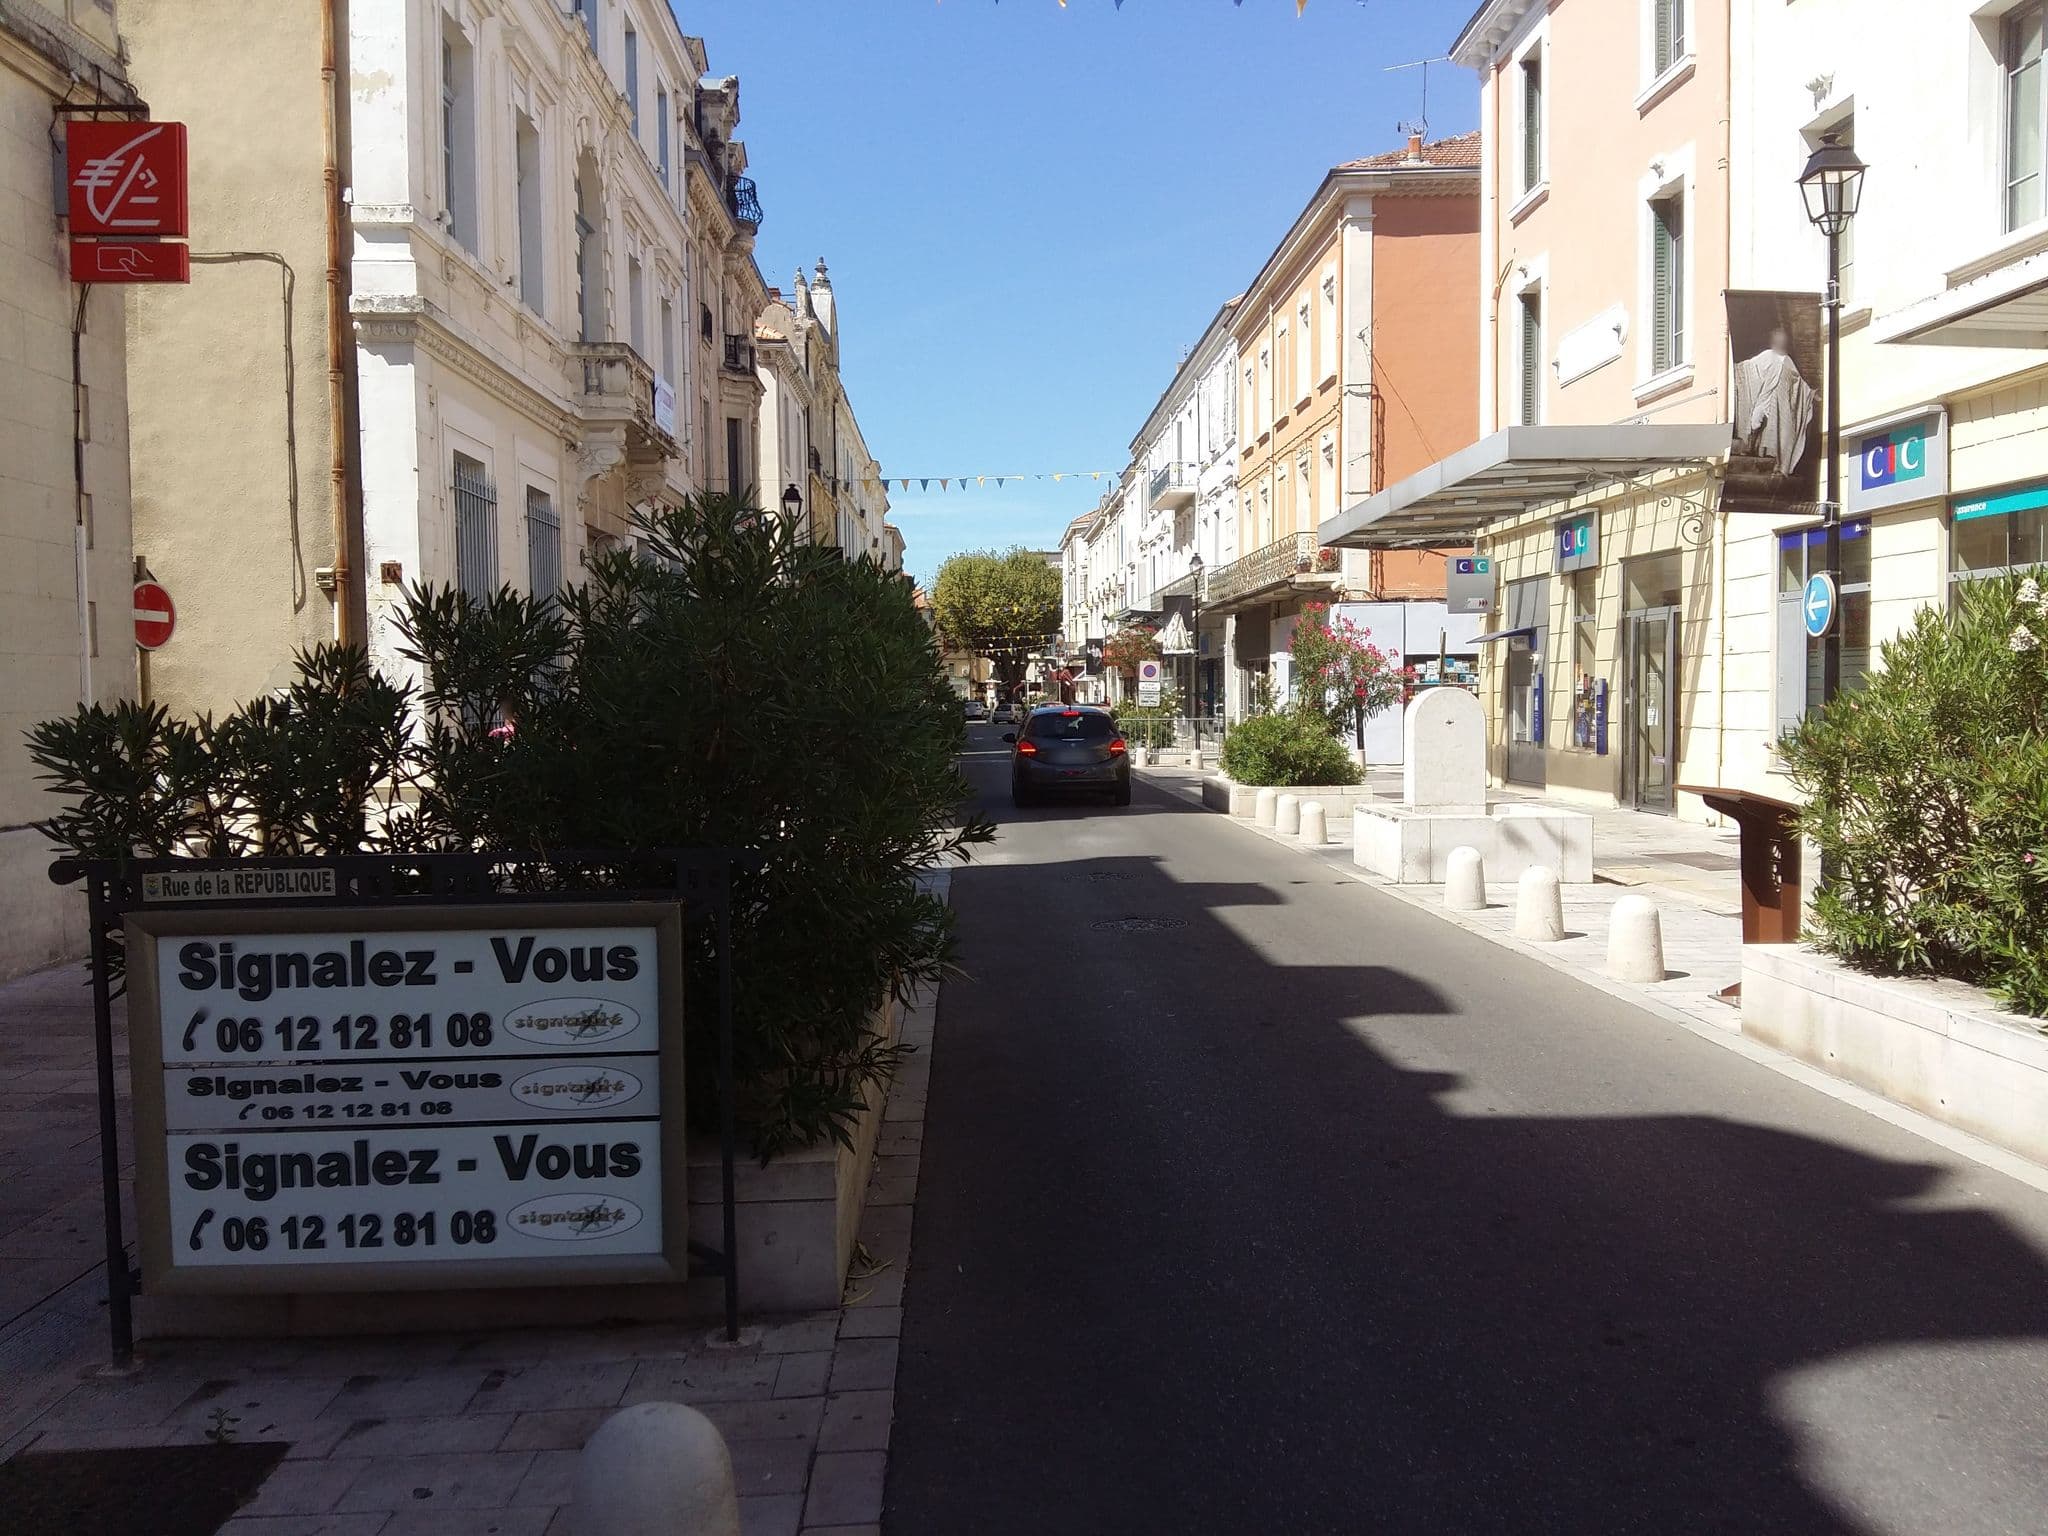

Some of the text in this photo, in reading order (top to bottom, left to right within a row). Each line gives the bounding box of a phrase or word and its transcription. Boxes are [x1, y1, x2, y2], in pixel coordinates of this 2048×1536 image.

[1866, 436, 1920, 478] CIC
[1562, 525, 1587, 551] CIC
[1459, 561, 1487, 572] CIC
[162, 871, 332, 896] Rue de la REPUBLIQUE
[178, 936, 640, 1001] Signalez - Vous
[216, 1012, 493, 1052] 06 12 12 81 08
[187, 1074, 363, 1100] Signalez
[399, 1070, 502, 1091] Vous
[261, 1101, 452, 1120] 06 12 12 81 08
[185, 1134, 642, 1201] Signalez - Vous
[223, 1210, 497, 1251] 06 12 12 81 08
